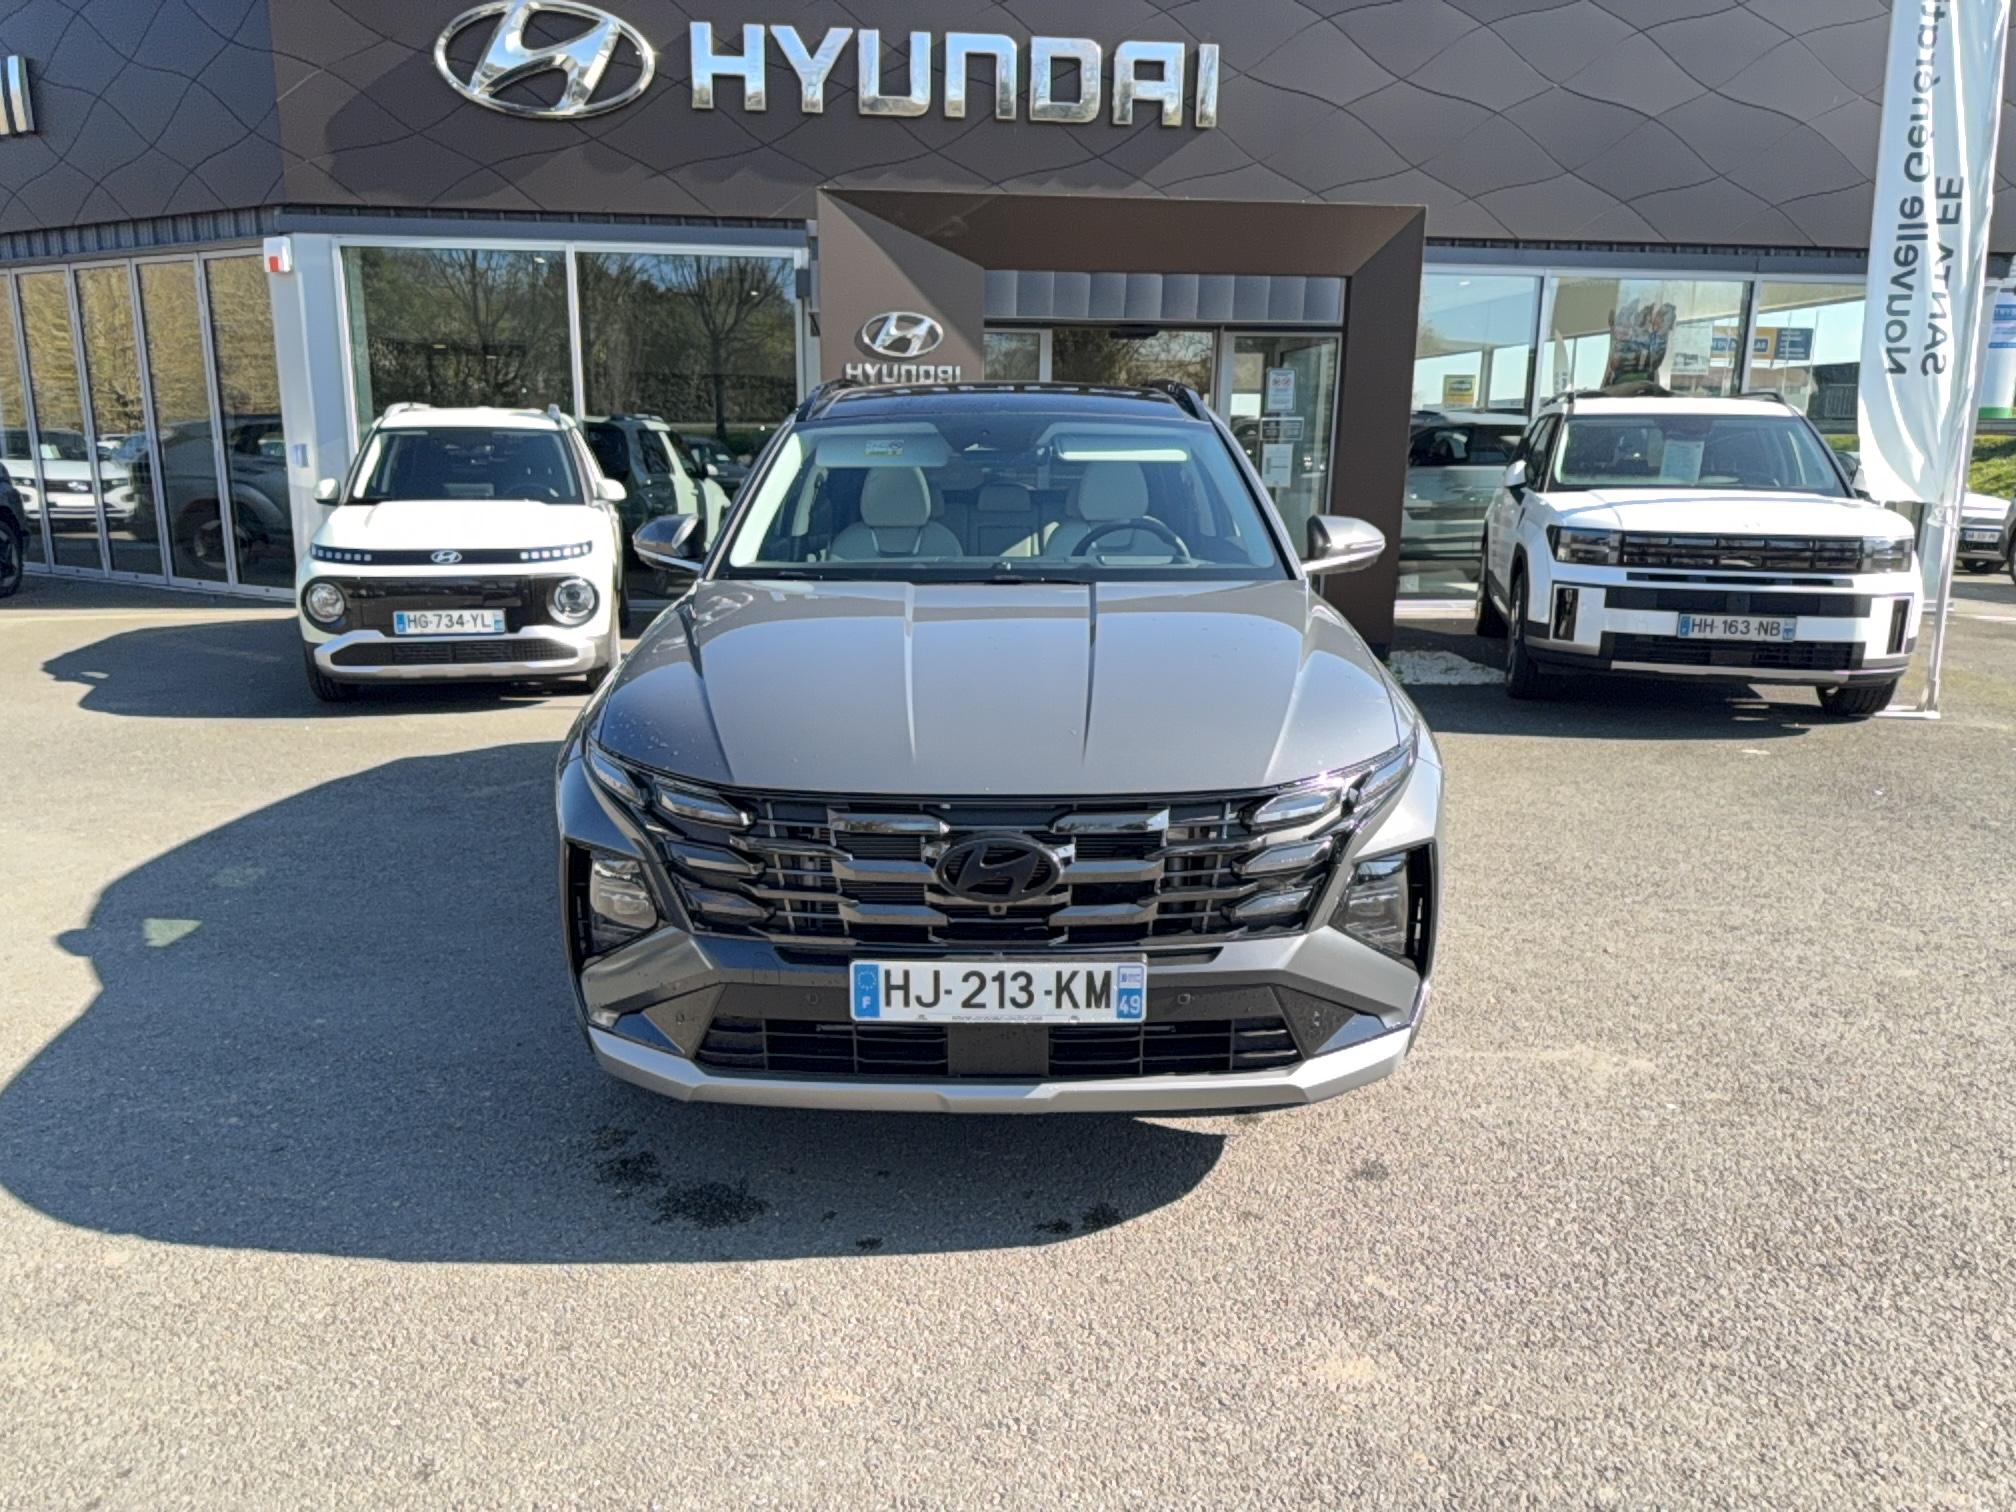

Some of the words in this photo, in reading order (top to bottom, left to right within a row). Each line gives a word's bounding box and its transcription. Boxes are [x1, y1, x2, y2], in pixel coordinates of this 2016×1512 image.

[689, 21, 1220, 128] HYUNDAI
[845, 362, 962, 384] HYUNDAI
[861, 995, 872, 1010] F
[884, 968, 1112, 1010] HJ-213-KM
[1119, 995, 1141, 1015] 49
